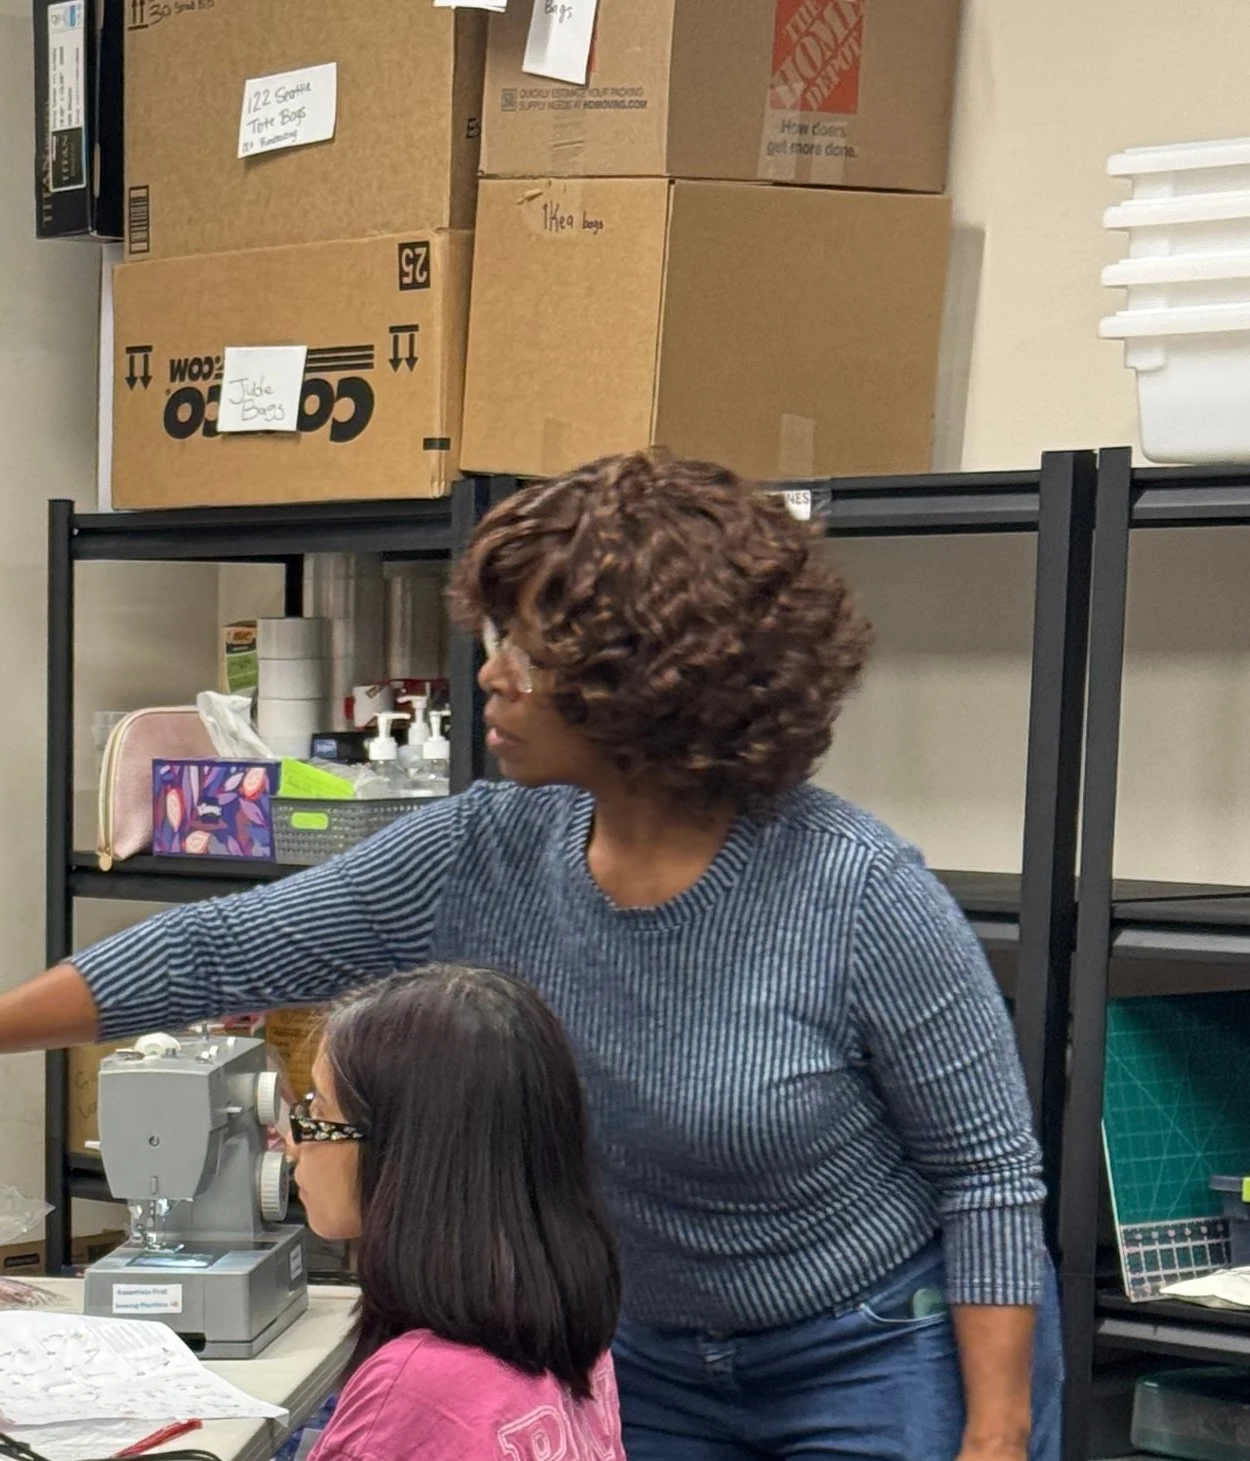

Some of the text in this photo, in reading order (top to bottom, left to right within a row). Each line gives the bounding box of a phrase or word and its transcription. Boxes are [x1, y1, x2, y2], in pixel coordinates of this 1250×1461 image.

[781, 120, 809, 134] How
[767, 140, 787, 156] get
[789, 142, 822, 156] more
